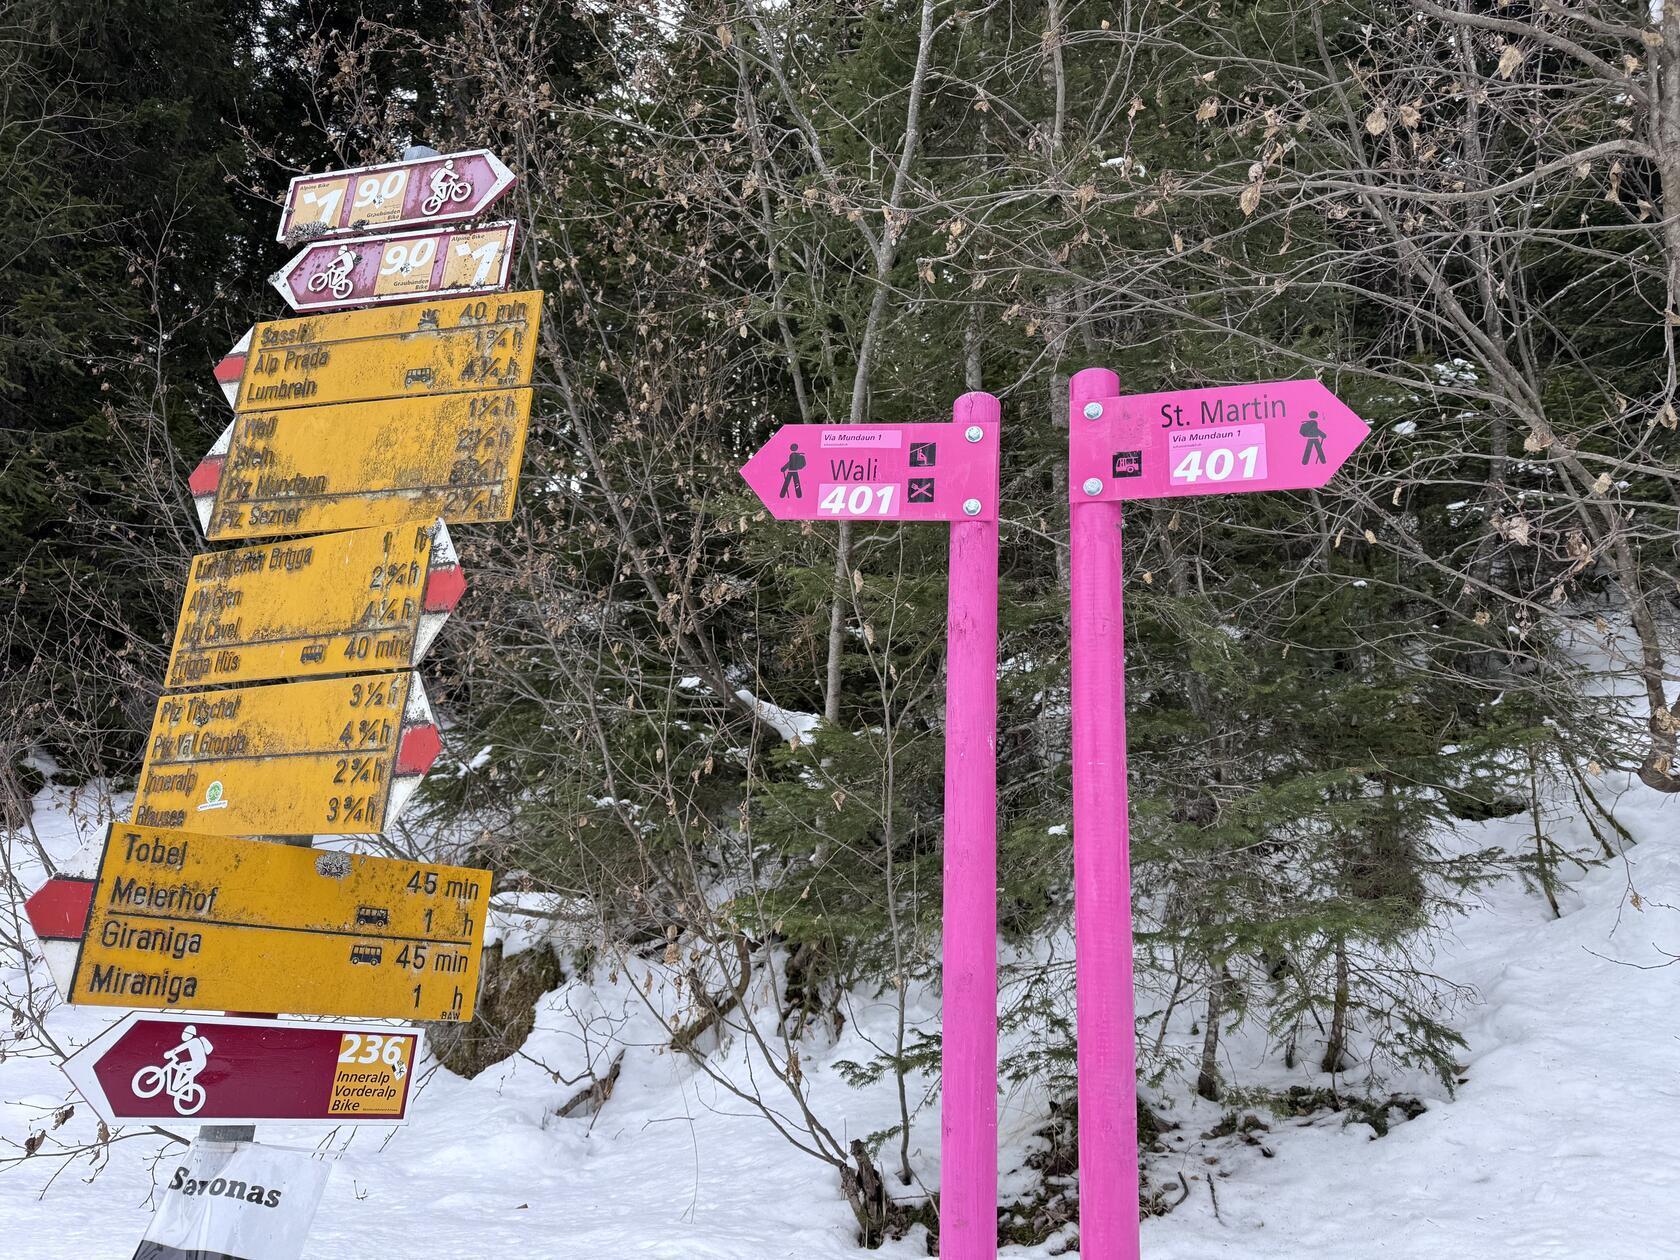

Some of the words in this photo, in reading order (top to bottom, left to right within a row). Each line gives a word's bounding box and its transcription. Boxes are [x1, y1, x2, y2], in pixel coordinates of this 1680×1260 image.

[353, 169, 407, 209] 90
[451, 234, 470, 242] Alpine
[380, 237, 436, 276] 90
[460, 301, 488, 321] 40
[496, 300, 527, 322] min
[254, 353, 279, 377] Alp
[284, 348, 330, 371] Prada
[247, 378, 318, 403] Lumbrein
[1161, 403, 1191, 429] St.
[1201, 394, 1287, 425] Martin
[824, 433, 836, 441] Via
[837, 433, 876, 441] Mundaun
[1172, 434, 1187, 443] Via
[1188, 431, 1234, 441] Mundaun
[830, 458, 879, 482] Wali
[1173, 446, 1259, 482] 401
[820, 485, 895, 516] 401
[249, 506, 304, 527] Sezner
[344, 635, 369, 660] 40
[375, 635, 405, 658] min
[380, 718, 391, 744] h
[372, 757, 384, 783] h
[365, 795, 377, 823] h
[125, 833, 188, 865] Tobel
[110, 876, 219, 912] Meierhof
[407, 870, 439, 895] 45
[445, 878, 480, 900] min
[424, 908, 433, 933] 1
[463, 912, 474, 937] h
[102, 920, 202, 959] Giraniga
[396, 944, 427, 970] 45
[434, 951, 469, 973] min
[89, 964, 198, 1003] Miraniga
[413, 983, 421, 1009] 1
[452, 985, 463, 1010] h
[441, 1011, 461, 1020] BAW
[337, 1034, 406, 1065] 236
[336, 1071, 390, 1086] Inneralp
[331, 1099, 360, 1112] Bike
[335, 1085, 397, 1101] Vorderalp
